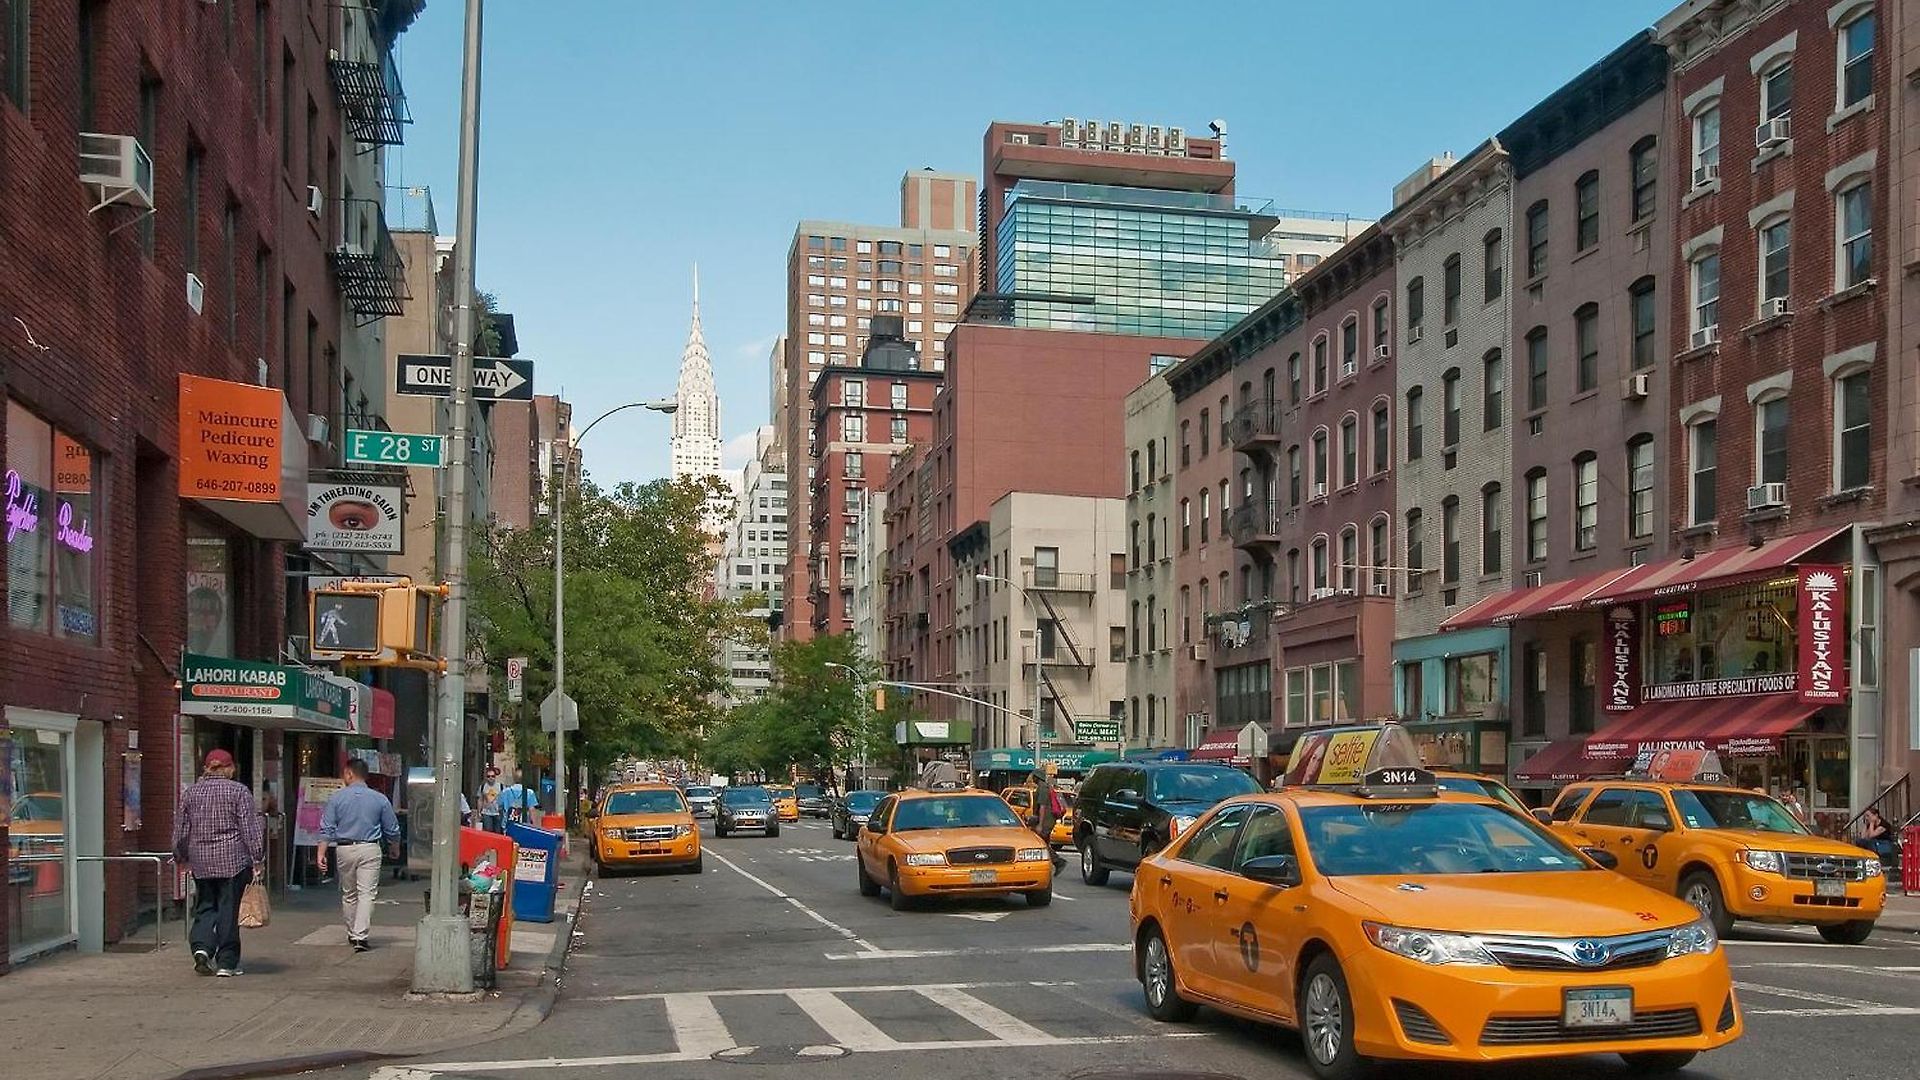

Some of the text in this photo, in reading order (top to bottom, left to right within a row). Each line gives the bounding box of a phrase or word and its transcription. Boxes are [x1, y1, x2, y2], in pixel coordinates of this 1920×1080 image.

[416, 367, 514, 389] ONE WAY
[198, 410, 278, 429] Maincure
[201, 429, 275, 448] Pedicure
[353, 434, 436, 460] E 28 ST
[206, 449, 270, 470] Waxing
[196, 478, 276, 494] 646-207-0899
[317, 486, 373, 505] THREADING
[373, 494, 398, 521] SALON
[1811, 591, 1833, 690] KALUSTYANS
[1613, 622, 1630, 705] KALUSTYANS
[186, 668, 286, 686] LAHORI KABAB
[1644, 675, 1796, 700] A LANDMARK FOR FINE SPECIALTY FOODS OF
[199, 686, 273, 696] RESTAURANT
[1330, 736, 1364, 766] selfie
[1637, 741, 1705, 752] KALUSTYAN'S
[1383, 770, 1417, 784] 3N14
